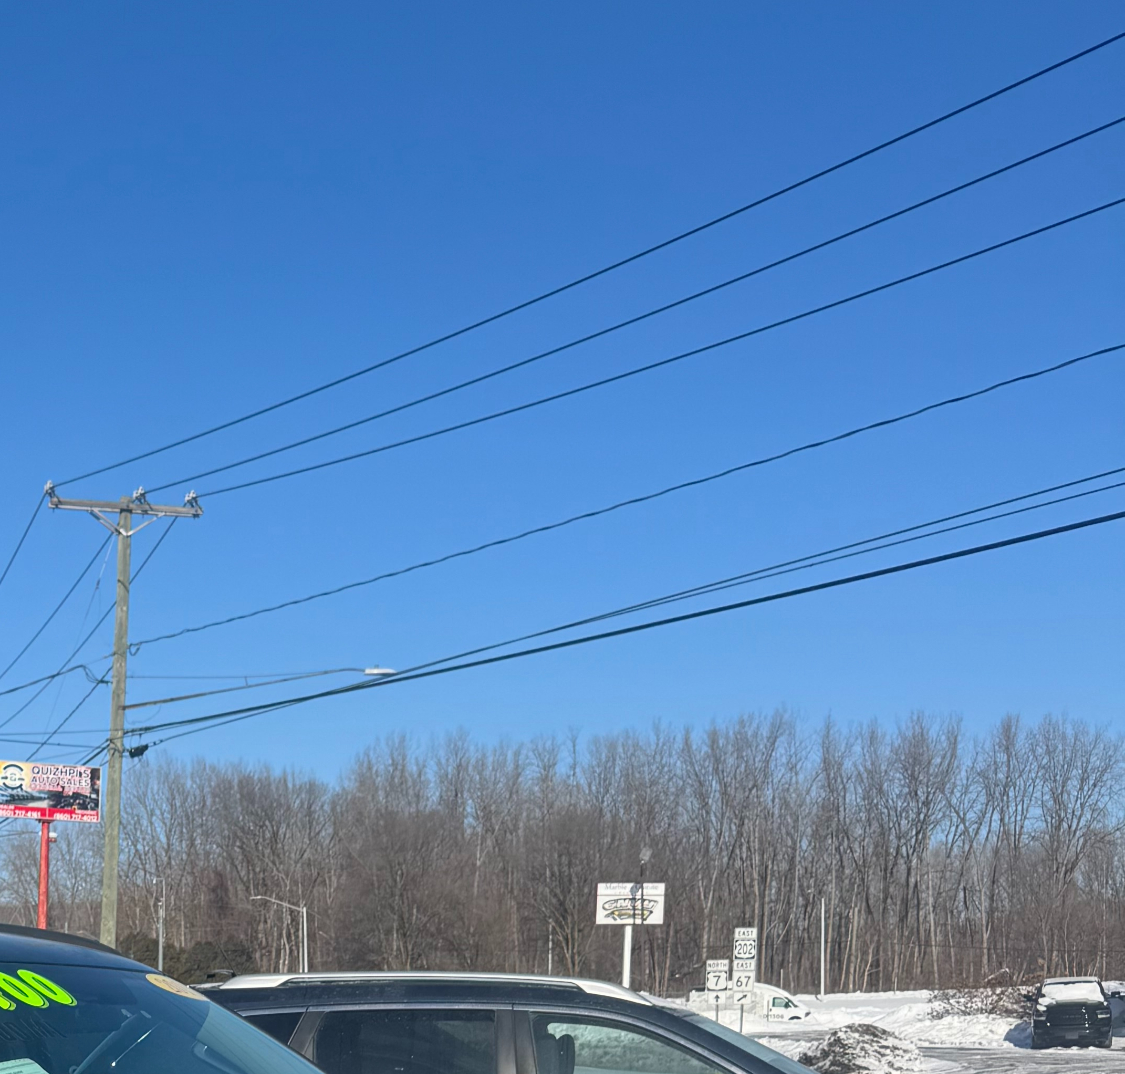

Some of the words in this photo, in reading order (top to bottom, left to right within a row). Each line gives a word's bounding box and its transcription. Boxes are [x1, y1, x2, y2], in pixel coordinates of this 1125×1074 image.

[31, 776, 58, 785] AUTO
[60, 778, 90, 787] SALES
[737, 943, 754, 955] 202
[712, 975, 721, 987] 7
[735, 976, 751, 988] 67
